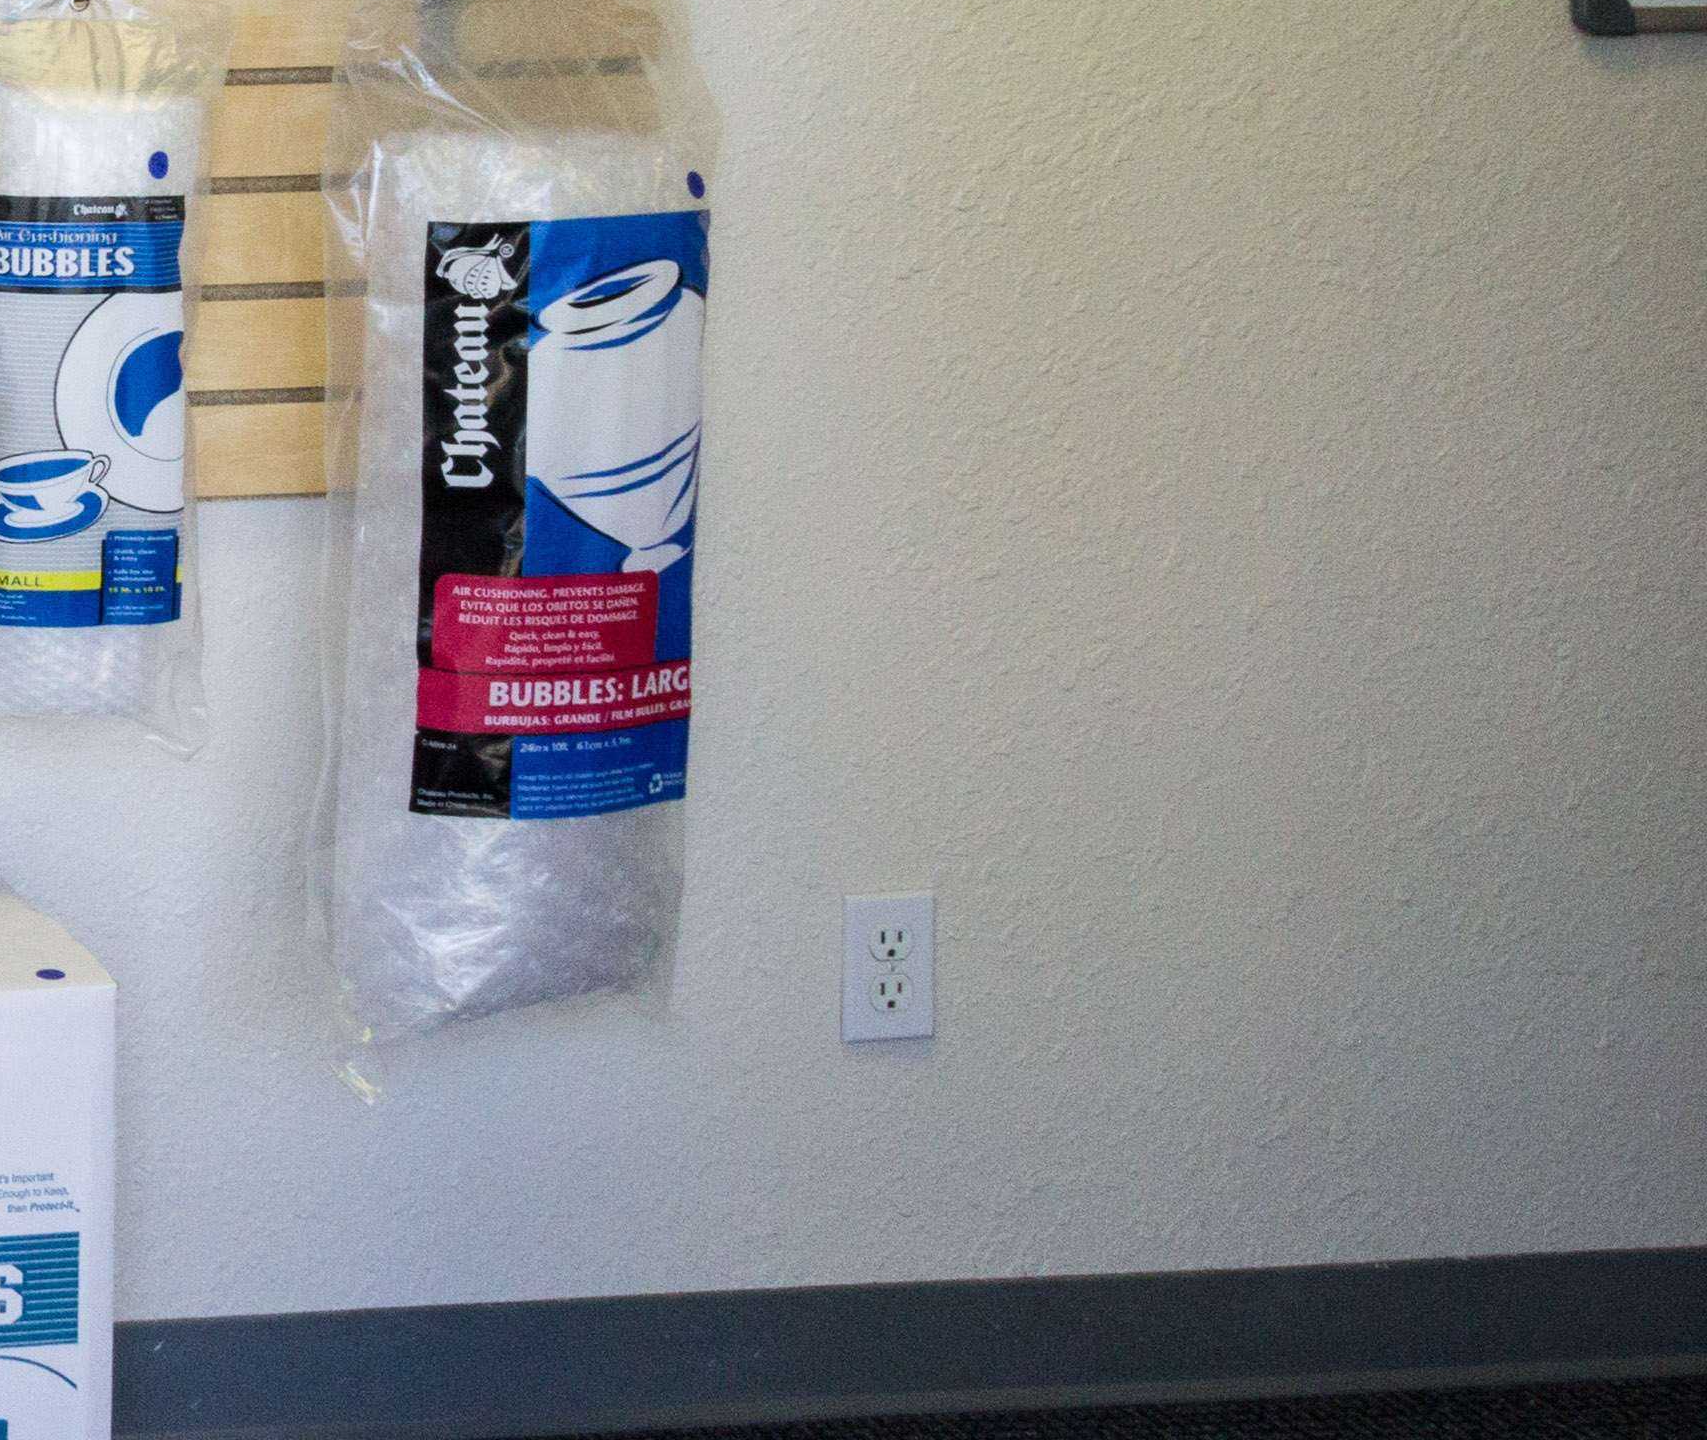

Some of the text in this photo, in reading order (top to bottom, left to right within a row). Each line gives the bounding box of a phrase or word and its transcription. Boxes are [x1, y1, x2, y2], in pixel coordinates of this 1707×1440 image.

[73, 203, 115, 215] Chateau
[442, 303, 495, 490] Chateau
[489, 666, 691, 708] BUBBLES: LARG
